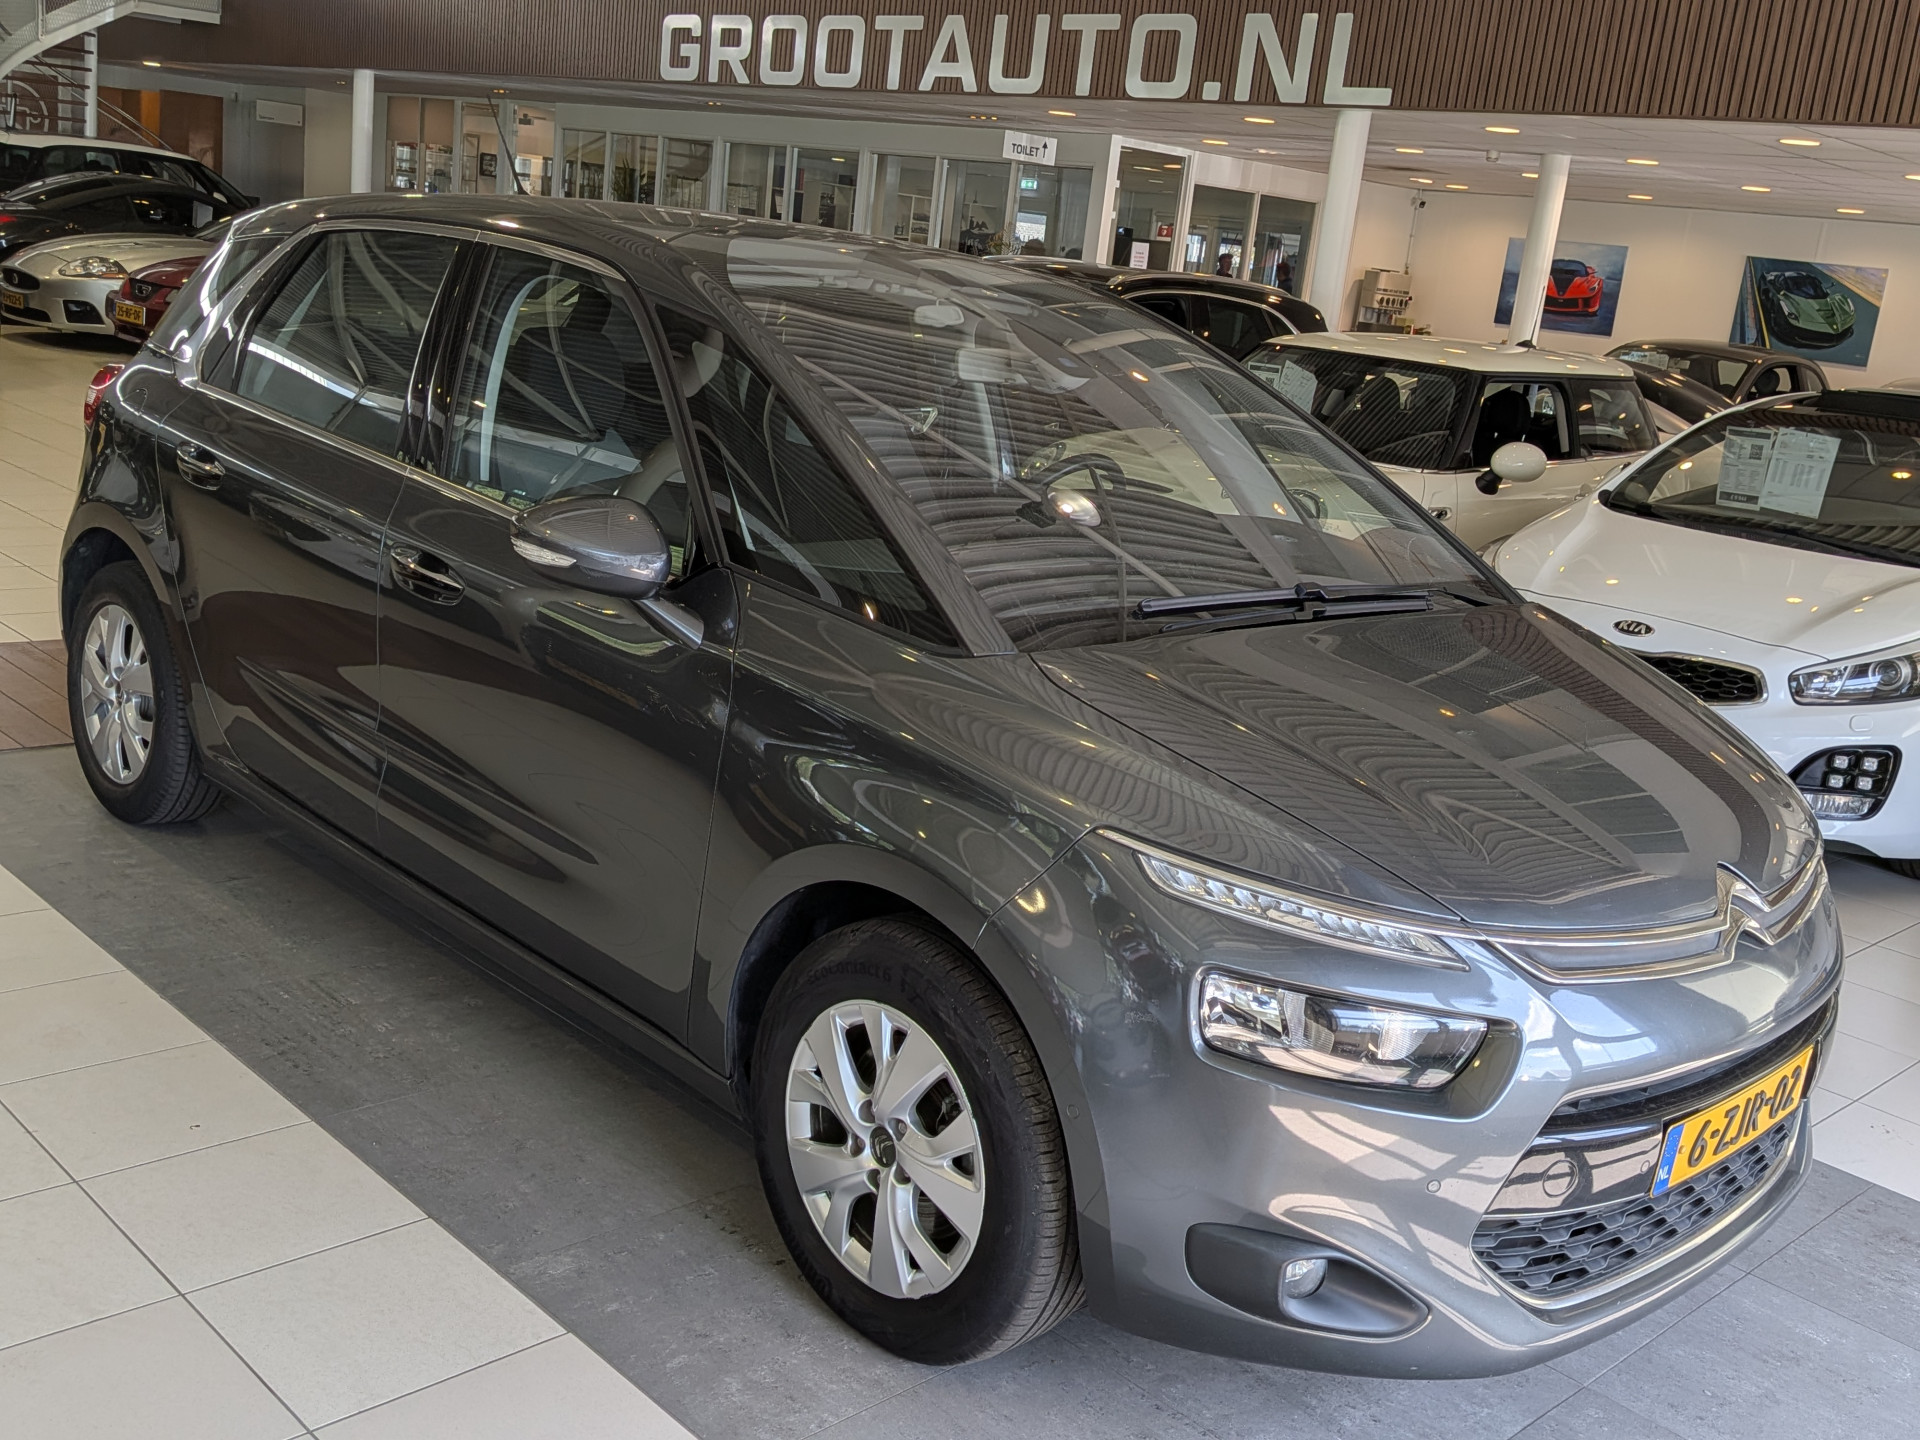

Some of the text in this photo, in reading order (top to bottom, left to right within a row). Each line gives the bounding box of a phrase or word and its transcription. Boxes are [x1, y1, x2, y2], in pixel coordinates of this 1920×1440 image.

[659, 12, 1393, 106] GROOTAUTO.NL
[1012, 142, 1040, 158] TOILET
[1618, 620, 1647, 634] KIA
[1687, 1064, 1803, 1168] 6-ZJR-02
[1657, 1165, 1669, 1182] NL
